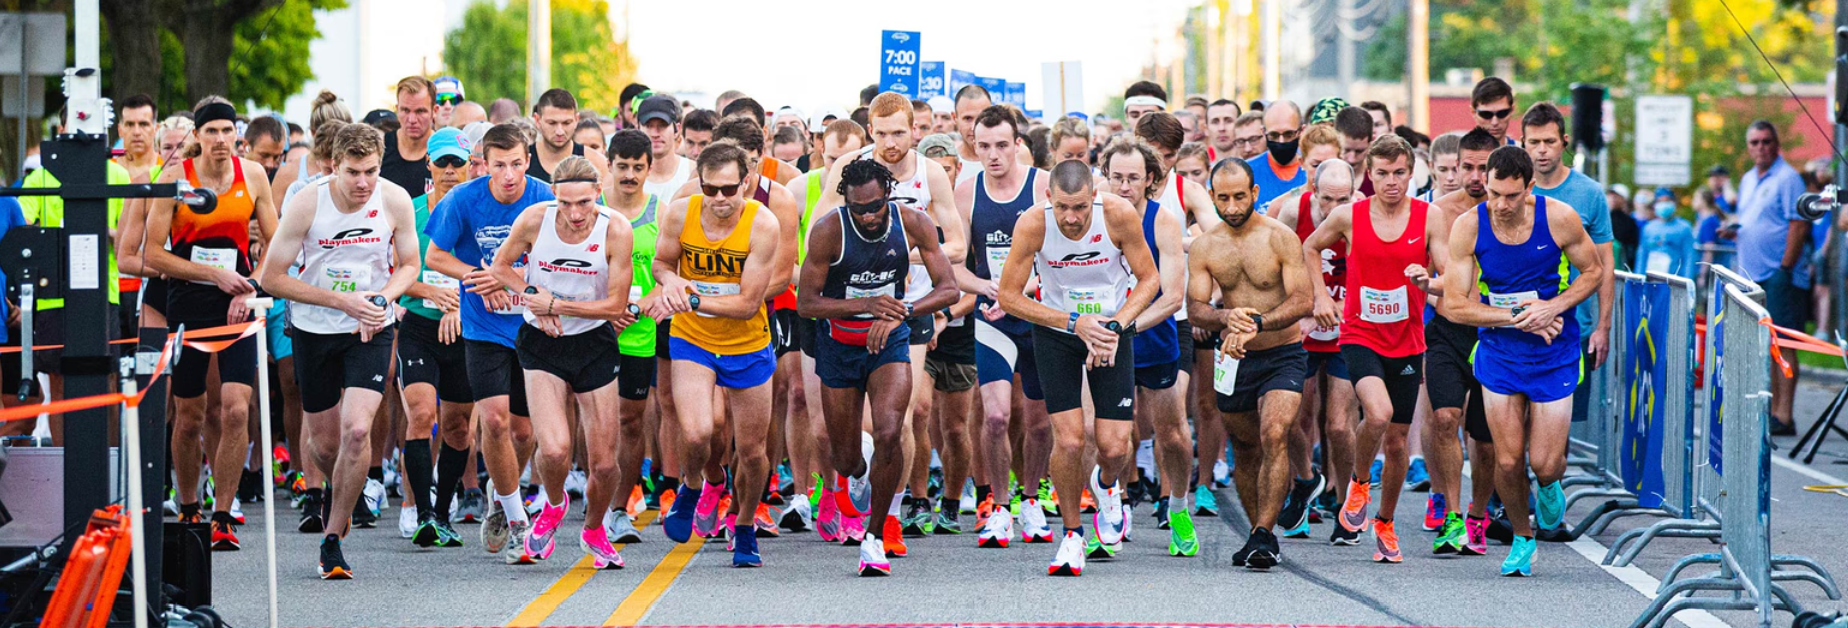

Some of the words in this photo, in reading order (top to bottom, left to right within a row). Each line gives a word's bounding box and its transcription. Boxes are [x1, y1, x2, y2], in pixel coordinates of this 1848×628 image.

[885, 50, 916, 65] 7:00
[888, 66, 912, 76] PACE
[318, 236, 381, 247] playmakers
[538, 260, 598, 275] playmakers
[1047, 257, 1110, 267] playmakers
[332, 280, 357, 292] 754
[1077, 302, 1102, 314] 660
[1368, 302, 1400, 315] 5690
